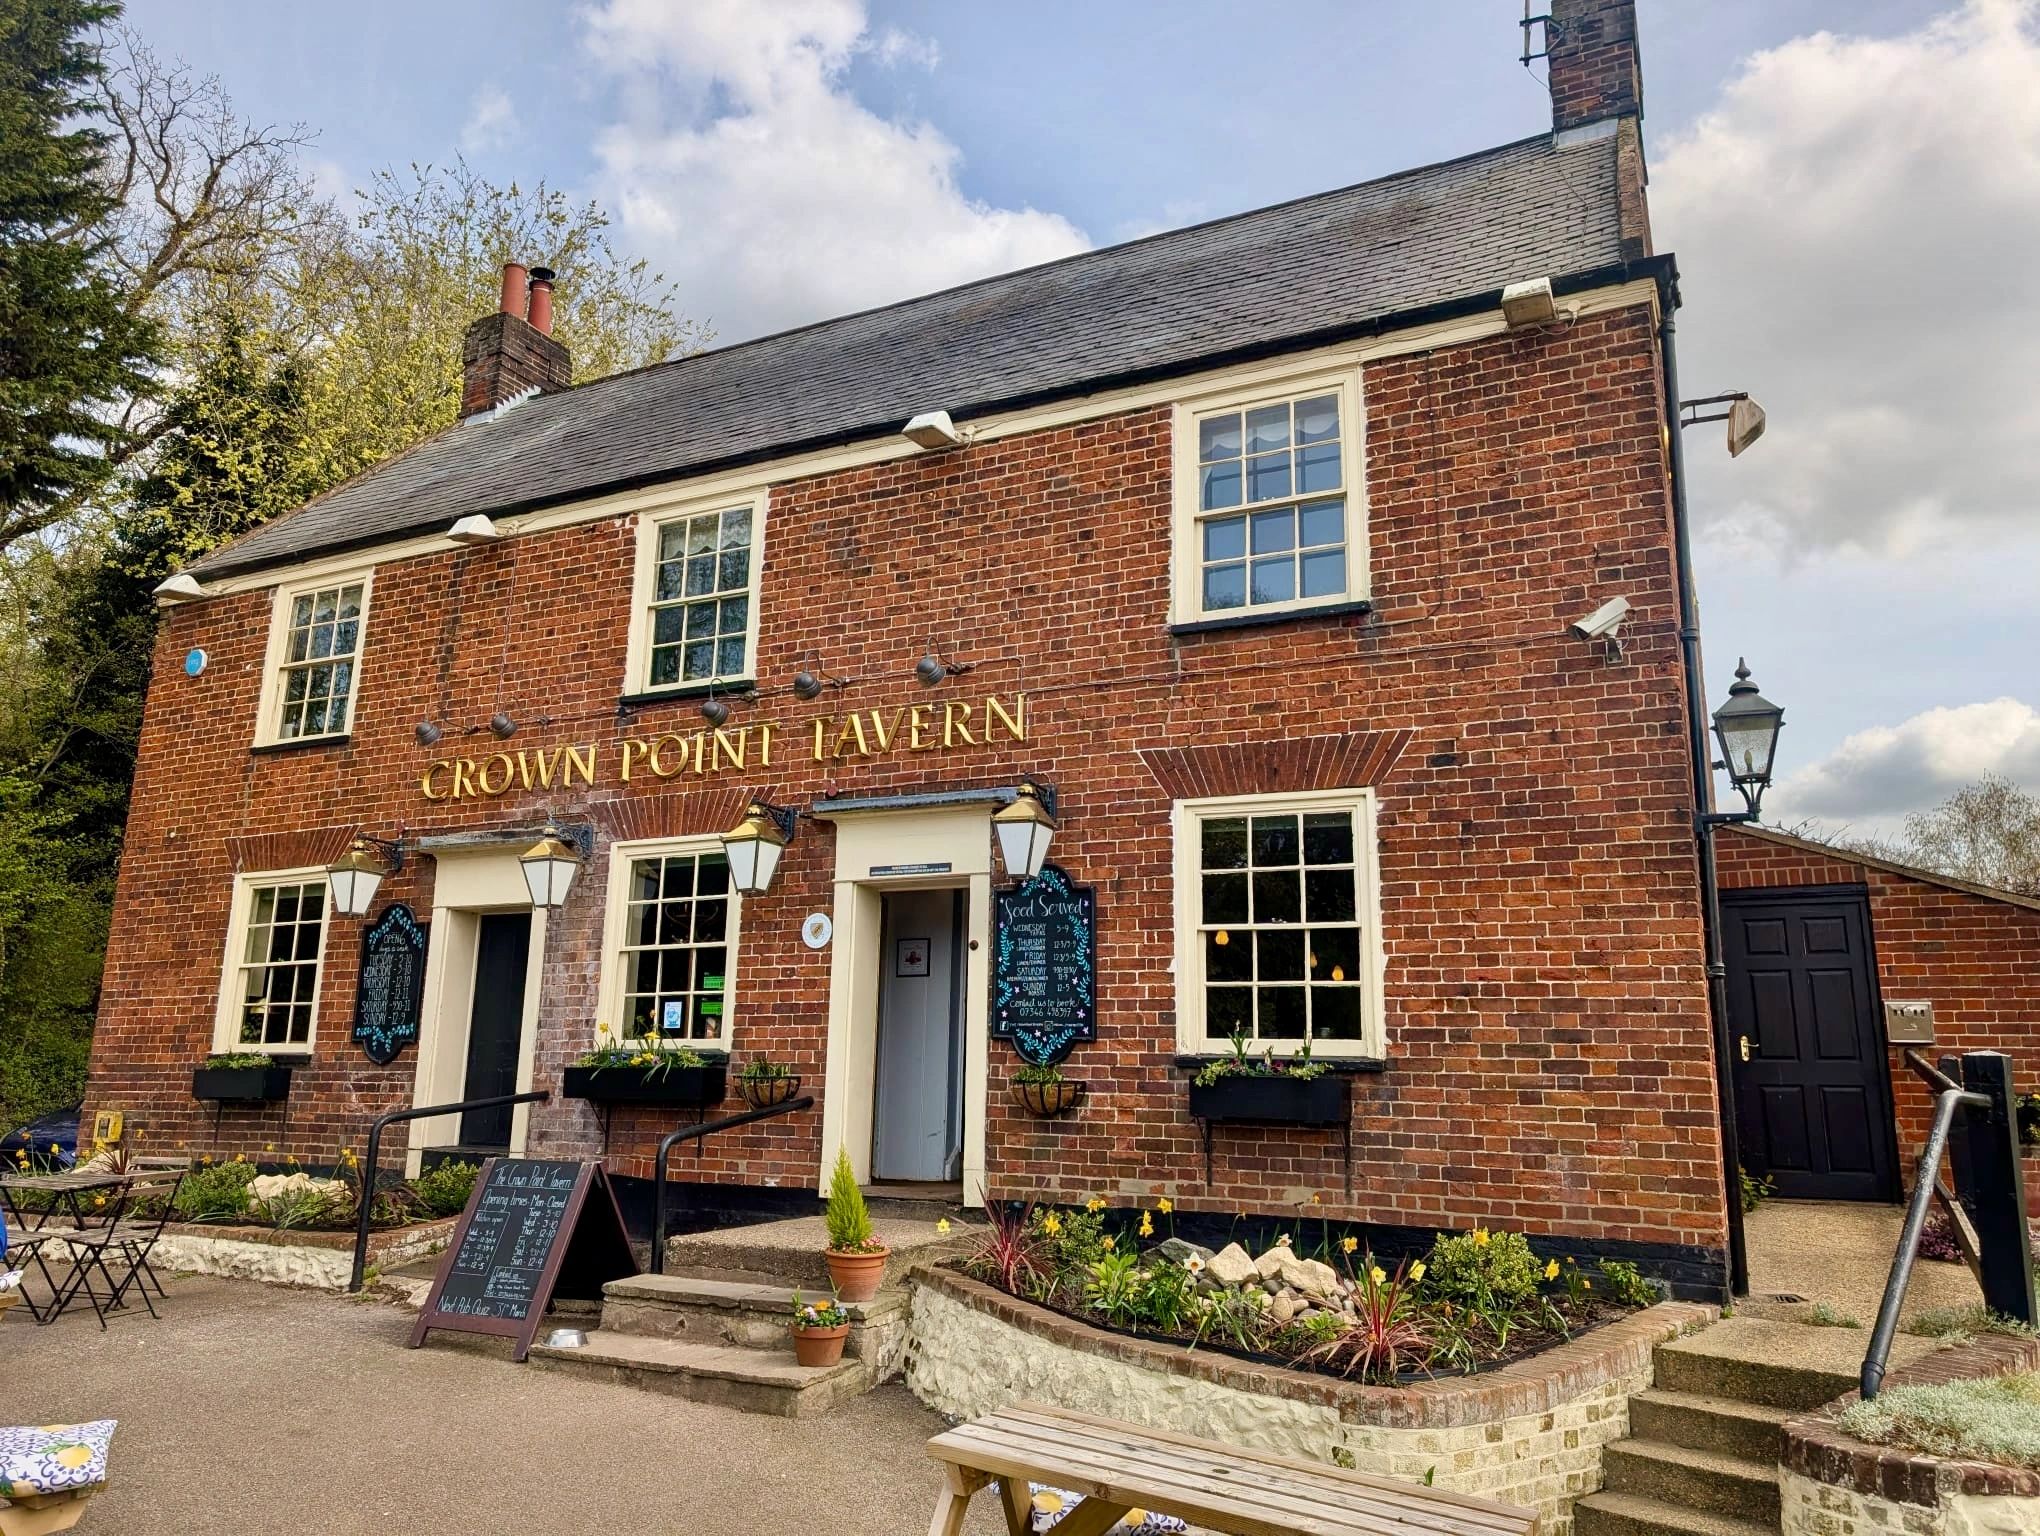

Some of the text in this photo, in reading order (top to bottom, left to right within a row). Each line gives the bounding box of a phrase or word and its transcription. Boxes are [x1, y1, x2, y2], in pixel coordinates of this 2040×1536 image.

[421, 693, 1026, 800] CROWN POINT TAVERN
[1039, 895, 1084, 917] Served
[1018, 938, 1046, 947] THURSDAY
[1024, 951, 1046, 960] FRIDAY
[1016, 966, 1047, 976] SATURDAY
[1022, 982, 1046, 992] SUNDAY
[368, 988, 389, 1001] FRIDAY
[360, 1000, 388, 1012] SATURDAY
[363, 1012, 386, 1025] SUNDAY
[496, 1164, 510, 1184] The
[508, 1164, 528, 1186] Crown
[550, 1166, 572, 1188] Tavern
[482, 1189, 510, 1212] Opening
[510, 1256, 523, 1266] Sun
